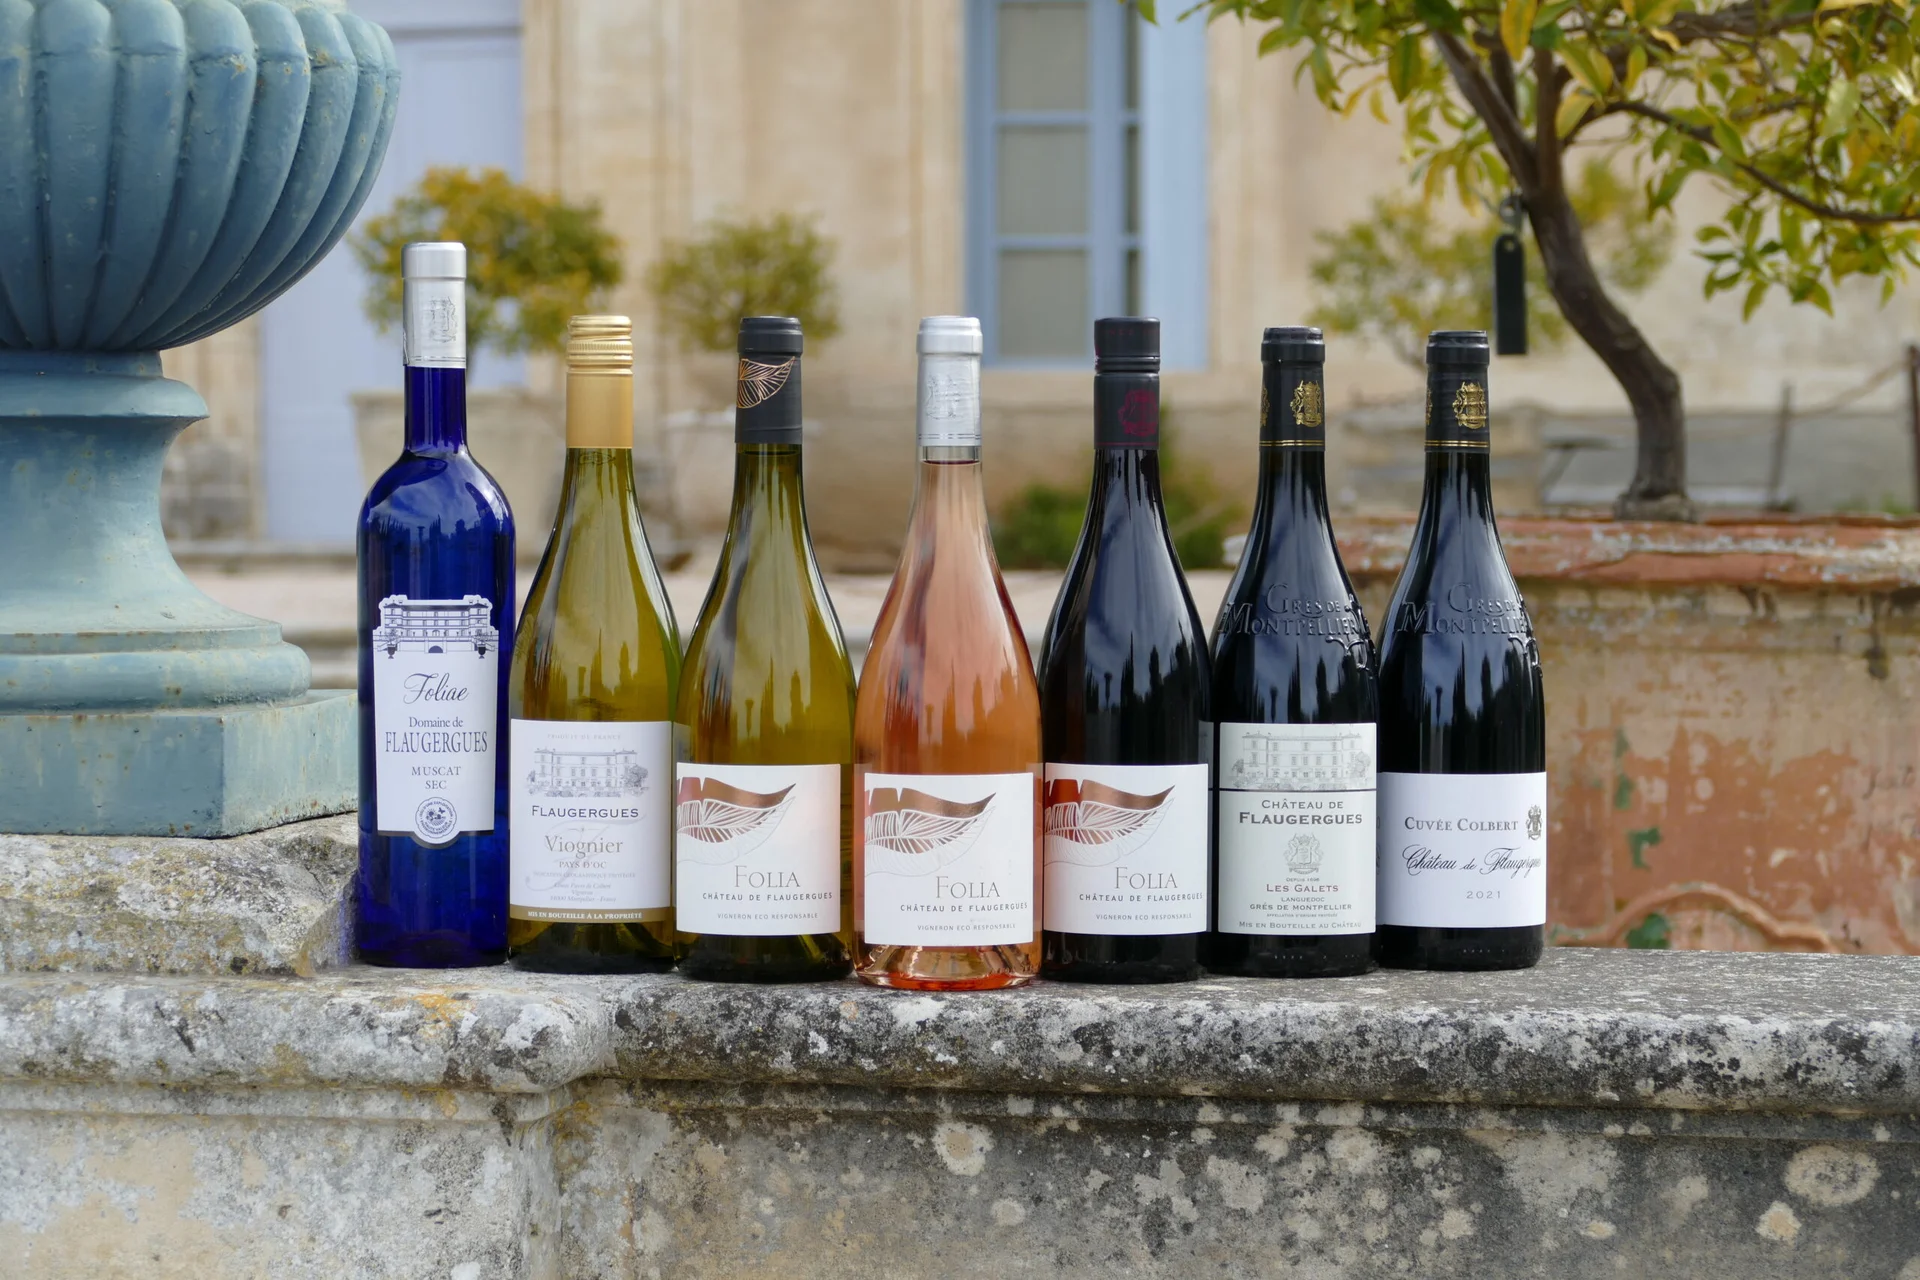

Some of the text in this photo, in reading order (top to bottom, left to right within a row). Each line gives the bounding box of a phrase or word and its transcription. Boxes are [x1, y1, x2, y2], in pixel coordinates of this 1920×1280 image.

[1327, 600, 1340, 612] DE
[1218, 603, 1359, 636] MONTPELLIER
[403, 673, 469, 704] Foliae
[409, 716, 464, 728] Domaine de
[385, 731, 488, 752] FLAUGERGUES
[412, 766, 461, 776] MUSCAT
[425, 780, 447, 790] SEC
[1262, 798, 1323, 809] CHÂTEAU
[532, 806, 639, 818] FLAUGERGUES
[1240, 812, 1362, 824] FLAUGERGUES
[1405, 816, 1518, 831] CUVÉE COLBERT
[545, 835, 623, 859] Viognier
[1402, 844, 1458, 876] Château
[1460, 858, 1477, 870] de
[734, 865, 800, 888] FOLIA
[1115, 866, 1178, 889] FOLIA
[936, 875, 1000, 899] FOLIA
[1266, 884, 1339, 892] LES GALETS
[702, 892, 743, 900] CHÂTEAU
[767, 892, 833, 900] FLAUGERGUES
[1080, 893, 1124, 902] CHÂTEAU
[1148, 892, 1203, 902] FLAUGERGUES
[1466, 890, 1501, 899] 2021
[900, 904, 944, 912] CHÂTEAU
[969, 902, 1028, 912] FLAUGERGUES
